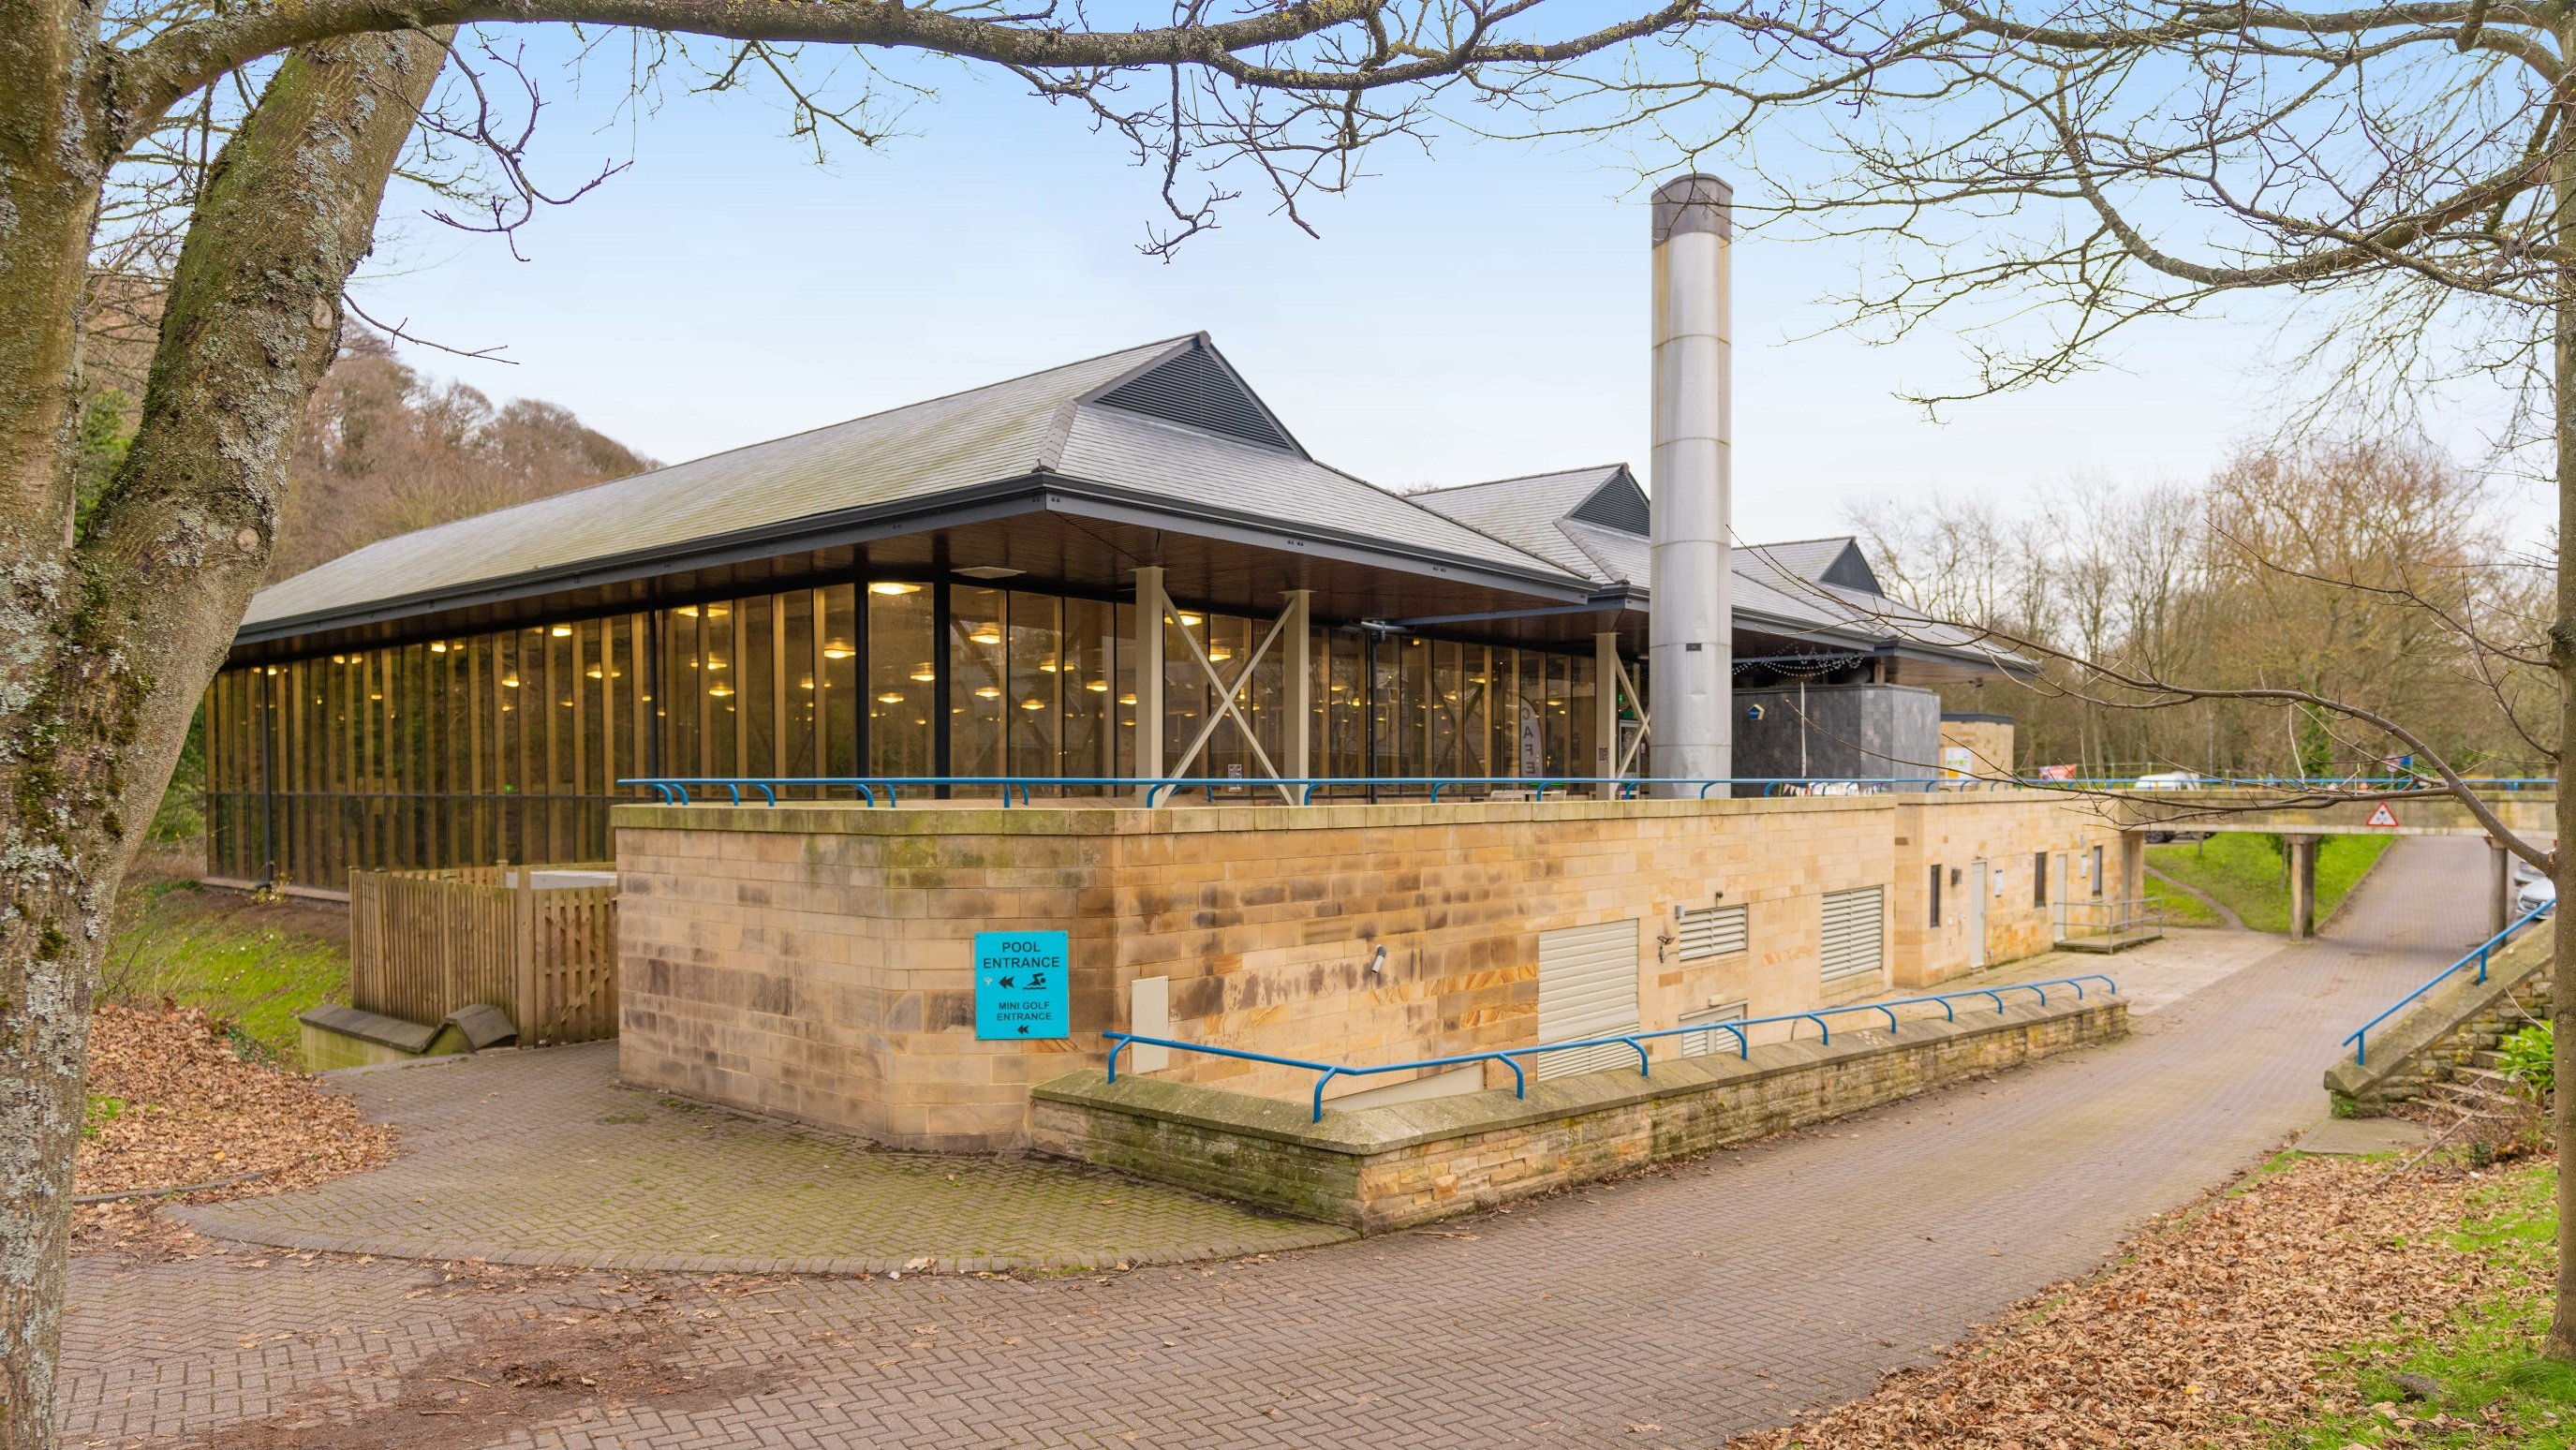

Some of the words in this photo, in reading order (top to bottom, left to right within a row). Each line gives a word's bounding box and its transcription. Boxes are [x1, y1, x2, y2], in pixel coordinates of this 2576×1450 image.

[1002, 941, 1042, 953] POOL
[983, 956, 1060, 969] ENTRANCE
[999, 1001, 1019, 1010] MINI
[1022, 1001, 1050, 1010] GOLF
[997, 1012, 1052, 1021] ENTRANCE
